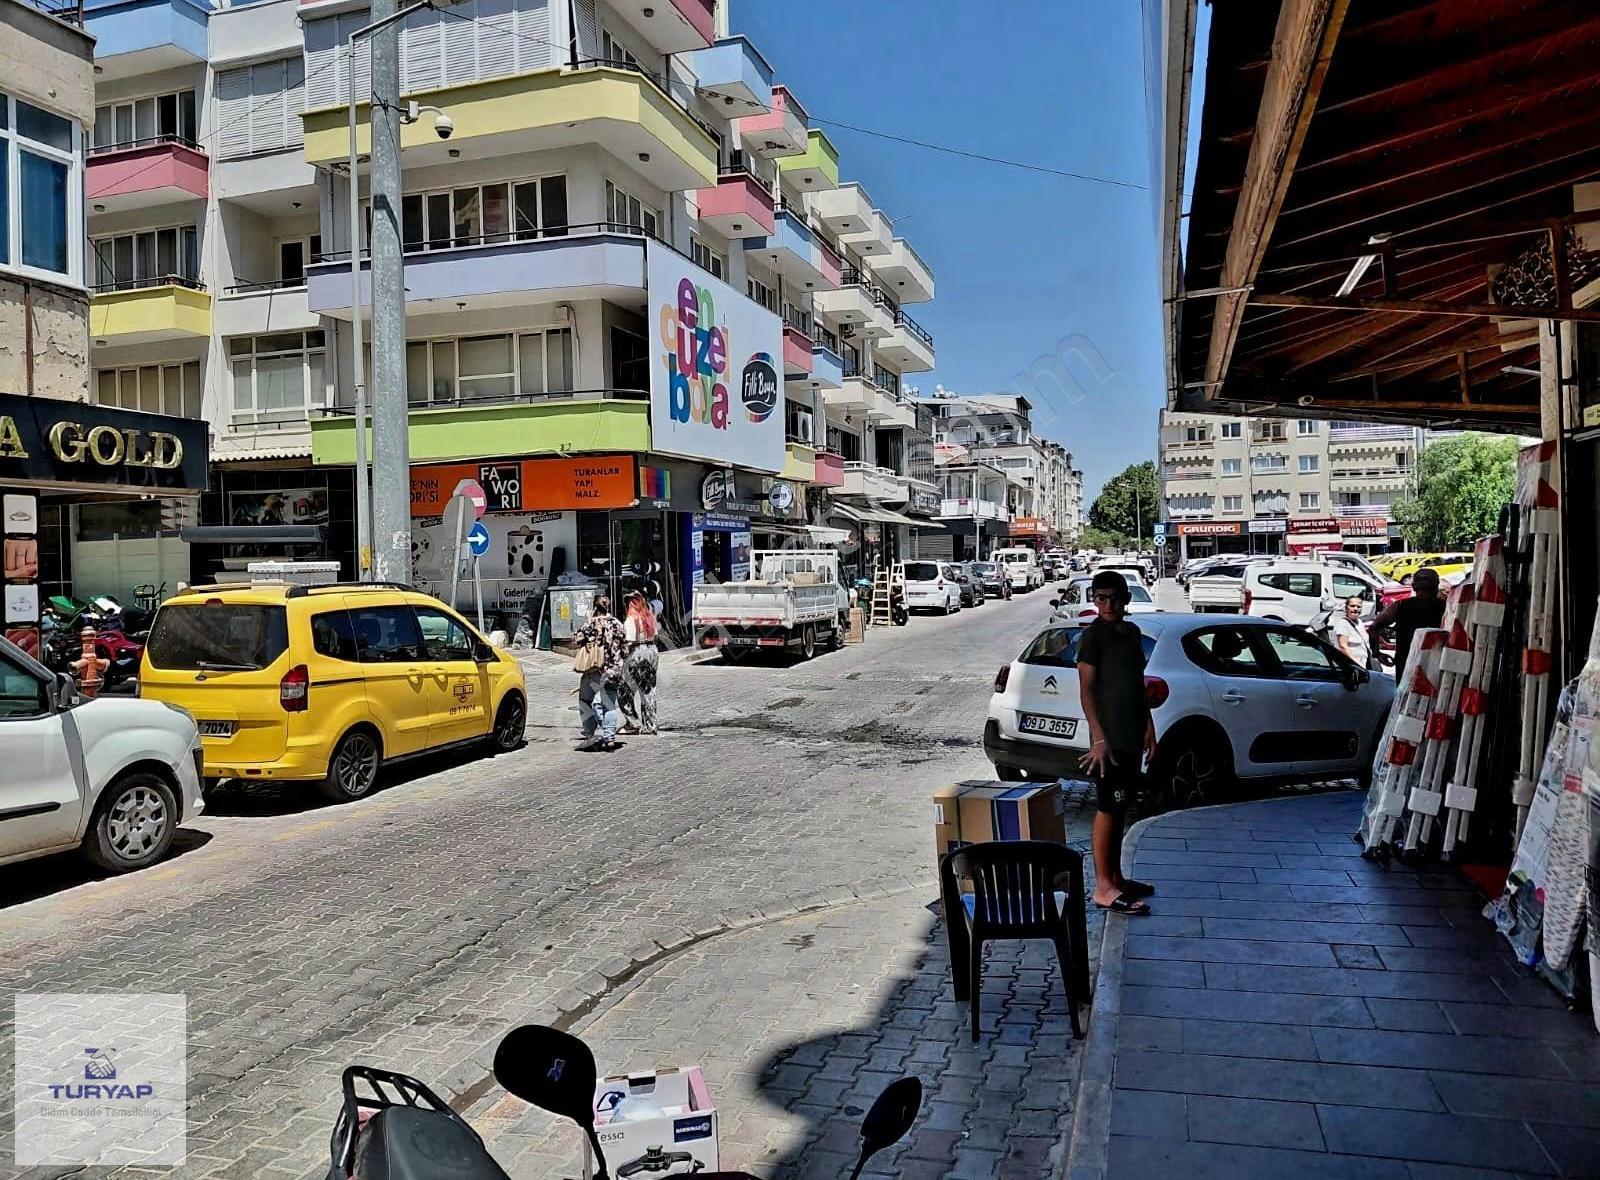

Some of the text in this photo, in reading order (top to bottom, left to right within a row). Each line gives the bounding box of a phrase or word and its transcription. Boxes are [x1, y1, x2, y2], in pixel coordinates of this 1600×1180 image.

[677, 277, 715, 330] en
[744, 371, 776, 403] Filli Boya
[0, 415, 184, 470] A GOLD
[480, 466, 500, 481] FA
[574, 467, 620, 477] TURANLAR
[491, 480, 520, 495] WO
[575, 490, 602, 498] MALZ.
[1183, 525, 1236, 533] GRUNDIG
[205, 721, 231, 734] 7074
[1025, 715, 1075, 735] 09 D 3657
